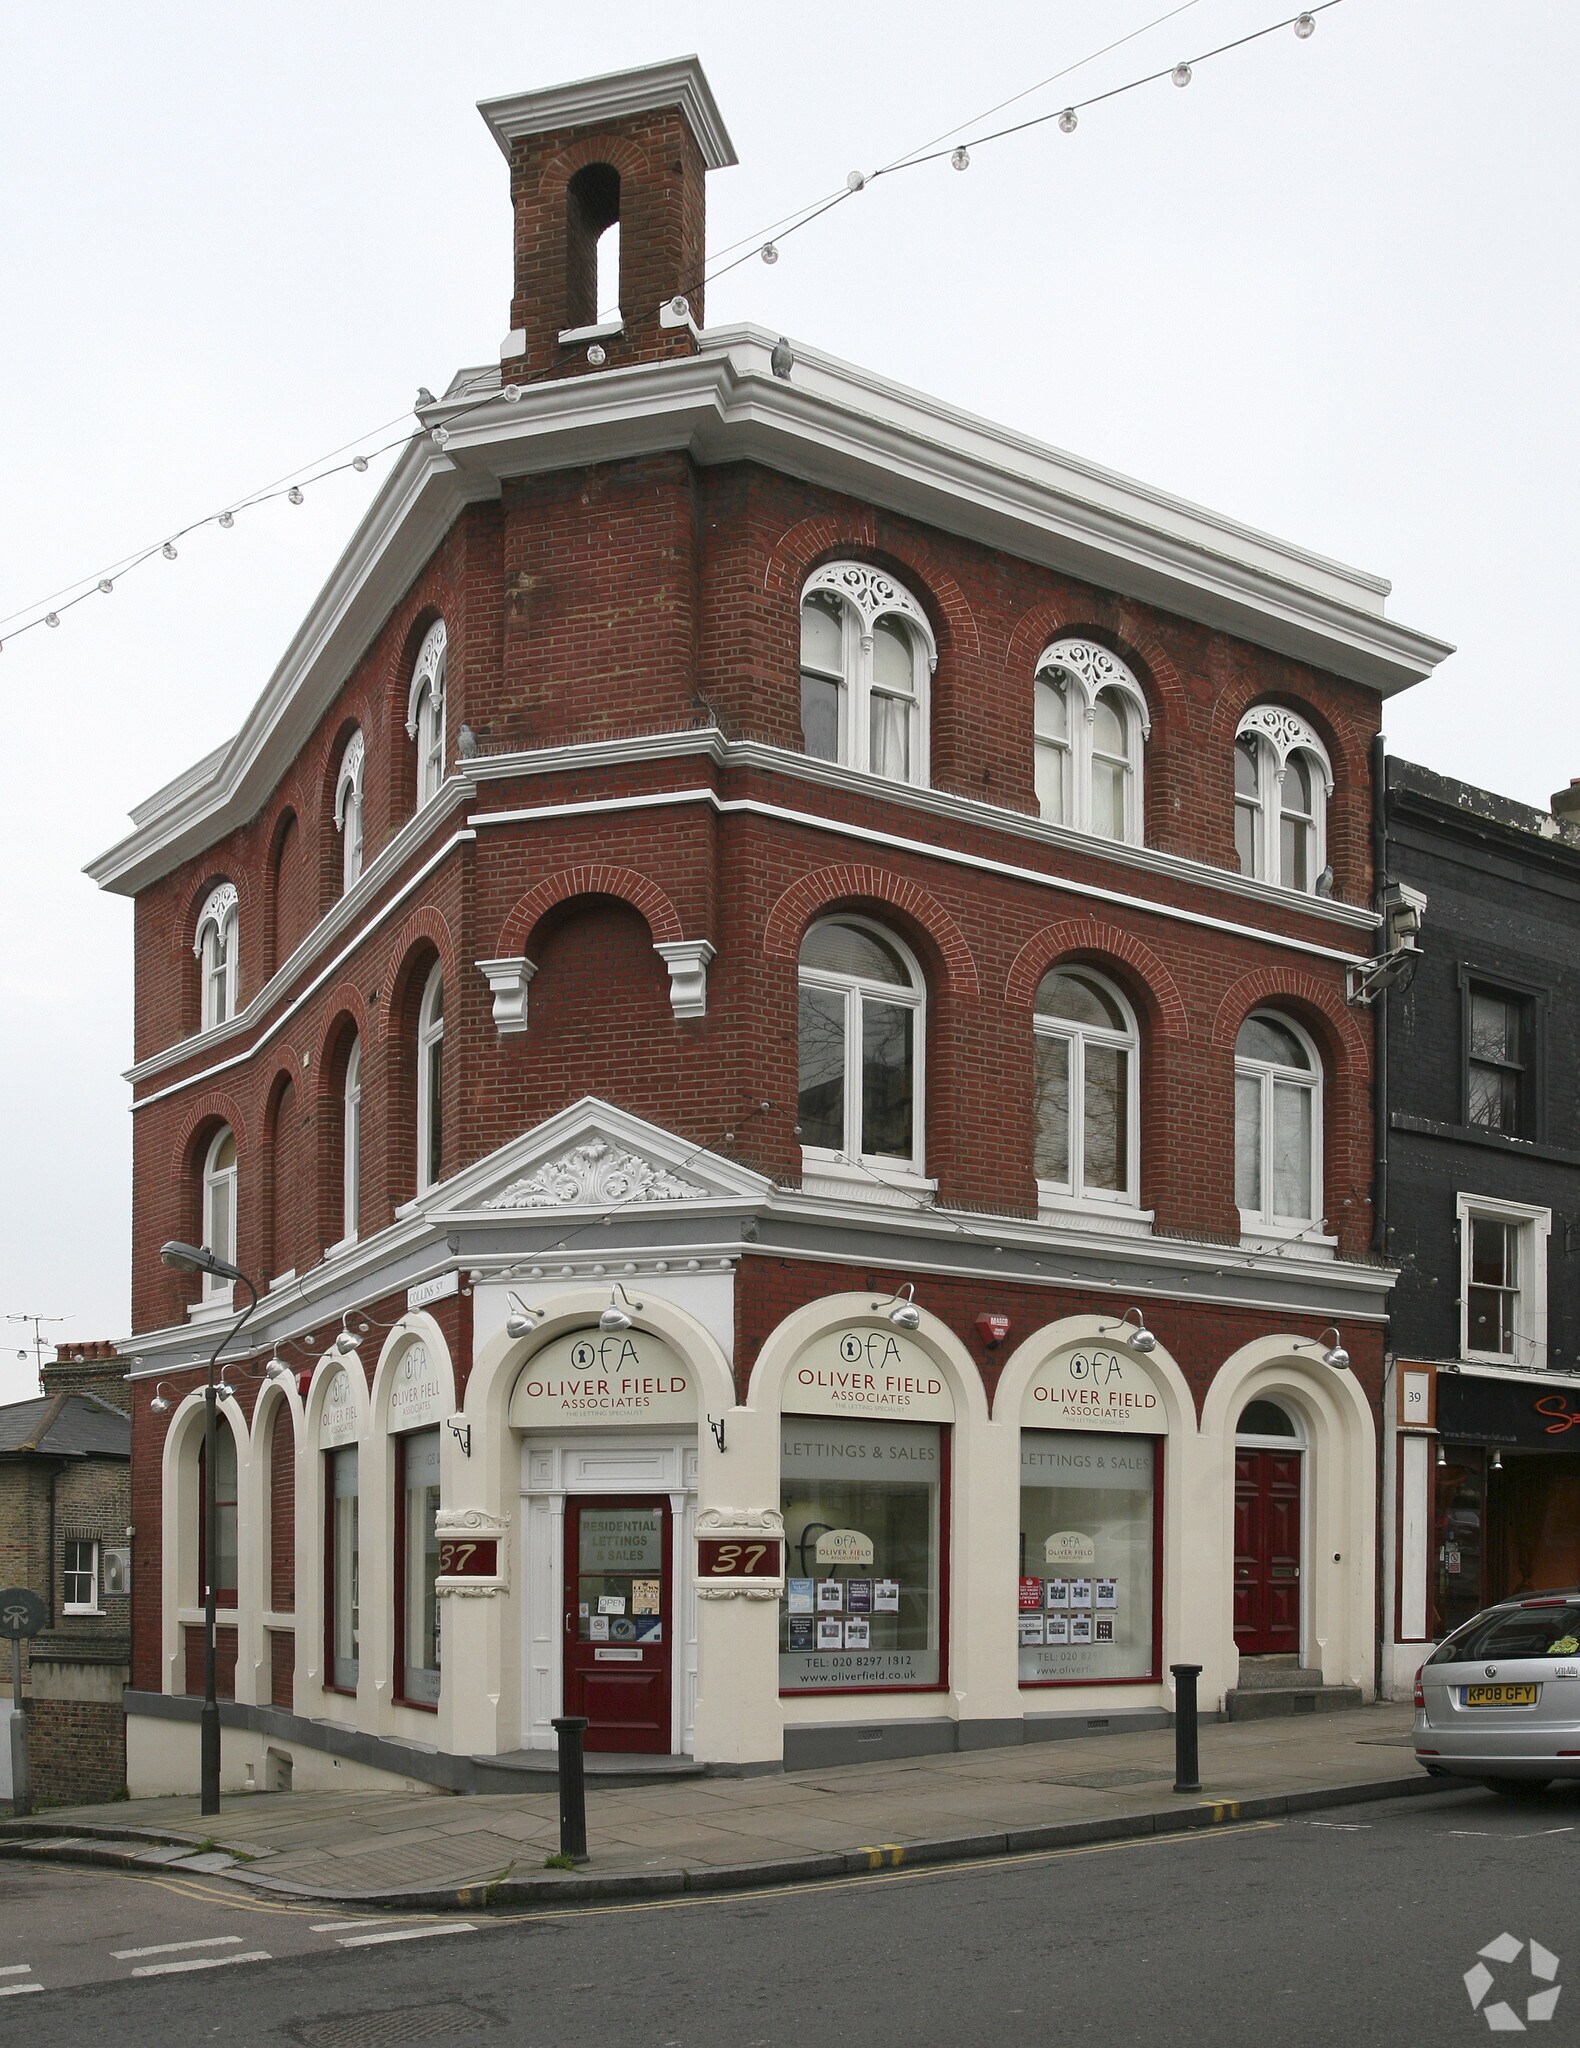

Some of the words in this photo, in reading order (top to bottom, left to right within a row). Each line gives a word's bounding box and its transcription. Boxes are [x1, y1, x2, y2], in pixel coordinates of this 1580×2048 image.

[410, 1285, 433, 1304] COLLINS
[436, 1281, 444, 1294] ST
[526, 1379, 610, 1397] OLIVER
[622, 1377, 687, 1395] FIELD
[798, 1369, 875, 1390] OLIVER
[886, 1376, 942, 1395] FIELD
[392, 1387, 418, 1407] OLIVER
[561, 1396, 650, 1409] ASSOCIATES
[831, 1390, 911, 1405] ASSOCIATES
[1034, 1387, 1100, 1405] OLIVER
[1109, 1392, 1157, 1408] FIELD
[1408, 1391, 1422, 1403] 39
[403, 1400, 431, 1415] ASSOCIATES
[848, 1403, 873, 1411] LETTING
[1062, 1406, 1130, 1419] ASSOCIATES
[322, 1409, 344, 1427] OLIVER
[784, 1442, 866, 1458] LETTINGS
[872, 1446, 883, 1459] &
[889, 1446, 935, 1461] SALES
[1021, 1453, 1091, 1468] LETTINGS
[1097, 1456, 1106, 1469] &
[1111, 1456, 1150, 1470] SALES
[583, 1520, 657, 1532] RESIDENTIAL
[592, 1535, 648, 1547] LETTINGS
[439, 1544, 477, 1571] 37
[597, 1550, 605, 1561] &
[608, 1550, 644, 1561] SALES
[711, 1545, 768, 1574] 37
[819, 1548, 847, 1556] OLIVER
[850, 1549, 872, 1557] FIELD
[600, 1598, 625, 1607] OPEN
[805, 1658, 829, 1668] TEL:
[832, 1657, 853, 1668] 020
[856, 1656, 882, 1667] 8297
[1037, 1652, 1058, 1662] TEL:
[1060, 1651, 1078, 1661] 020
[800, 1670, 917, 1682] www.oliverfield.co.uk
[1469, 1687, 1502, 1701] KP08
[1505, 1686, 1533, 1700] GFY
